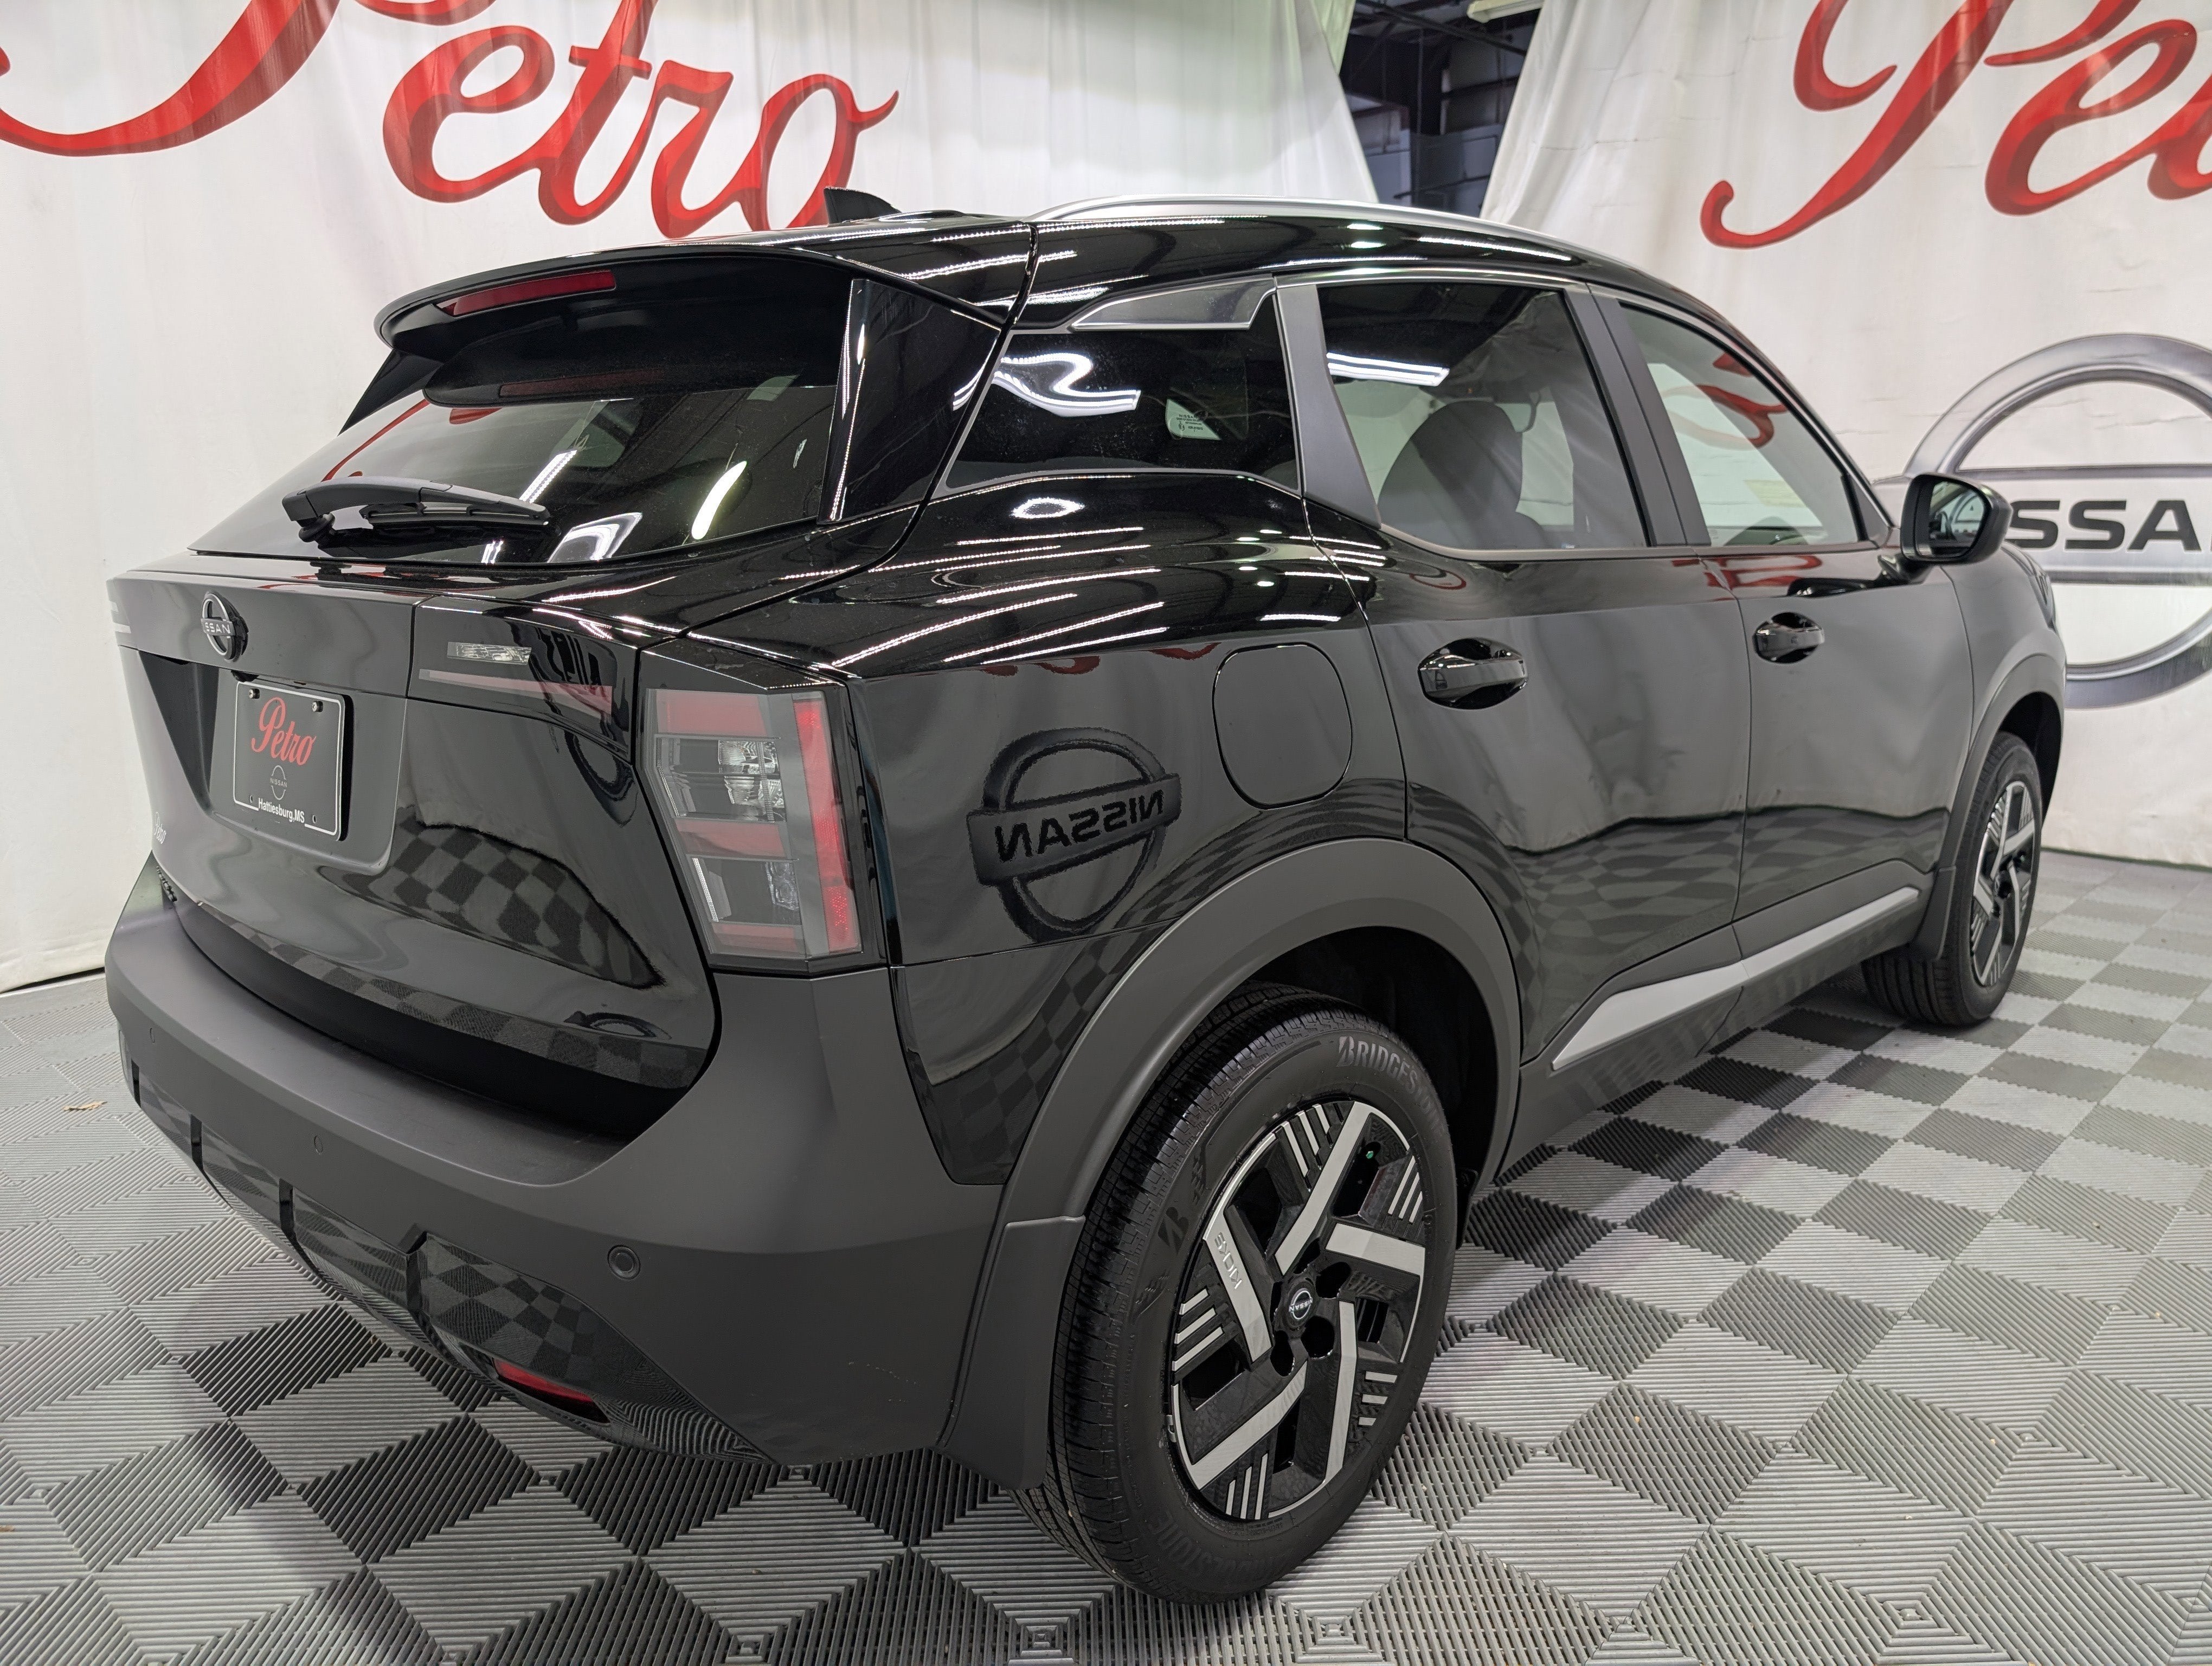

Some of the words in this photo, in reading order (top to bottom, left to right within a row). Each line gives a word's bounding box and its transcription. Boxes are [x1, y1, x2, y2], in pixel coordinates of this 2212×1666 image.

[2004, 499, 2212, 552] SSA
[204, 622, 231, 634] SSAN
[251, 696, 317, 766] Petro
[270, 778, 287, 788] NISSAN
[1214, 1232, 1243, 1290] KICKS
[1289, 1297, 1313, 1312] NISSAN
